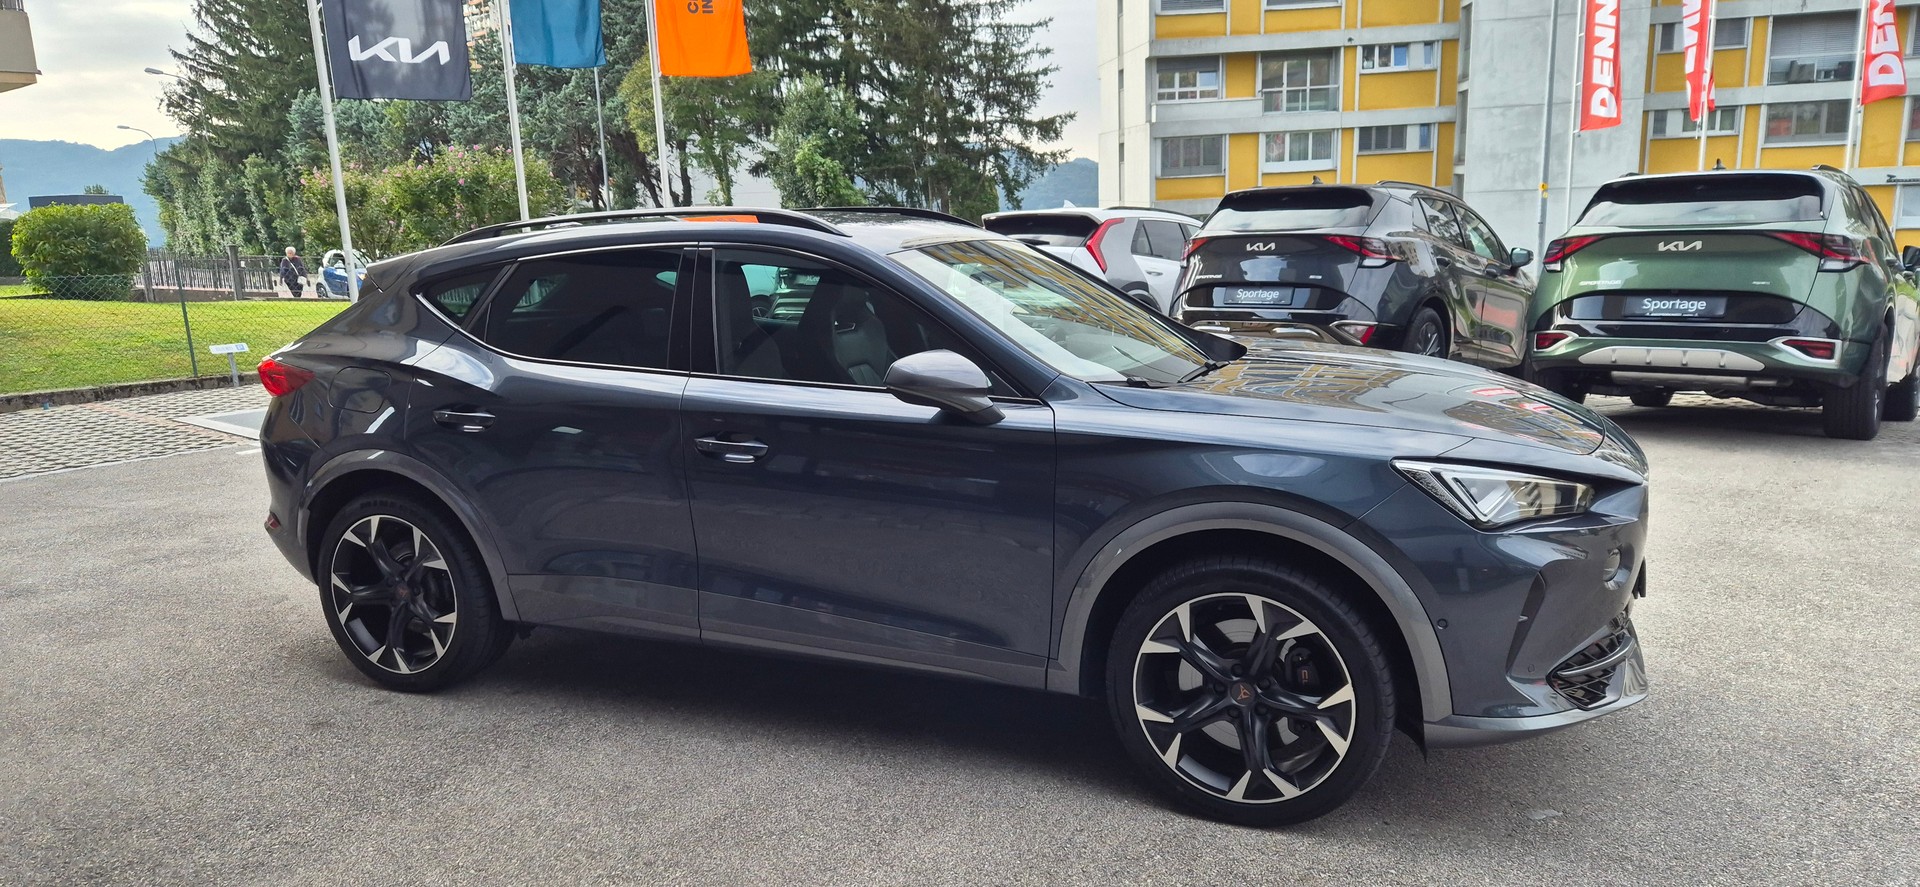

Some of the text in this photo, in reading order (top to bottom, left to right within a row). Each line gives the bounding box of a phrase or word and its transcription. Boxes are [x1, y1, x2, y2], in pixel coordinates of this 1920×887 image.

[348, 35, 450, 65] KIA
[1246, 242, 1276, 251] KIA
[1658, 240, 1703, 251] KIA
[1236, 288, 1280, 300] Sportage
[1642, 298, 1707, 312] Sportage
